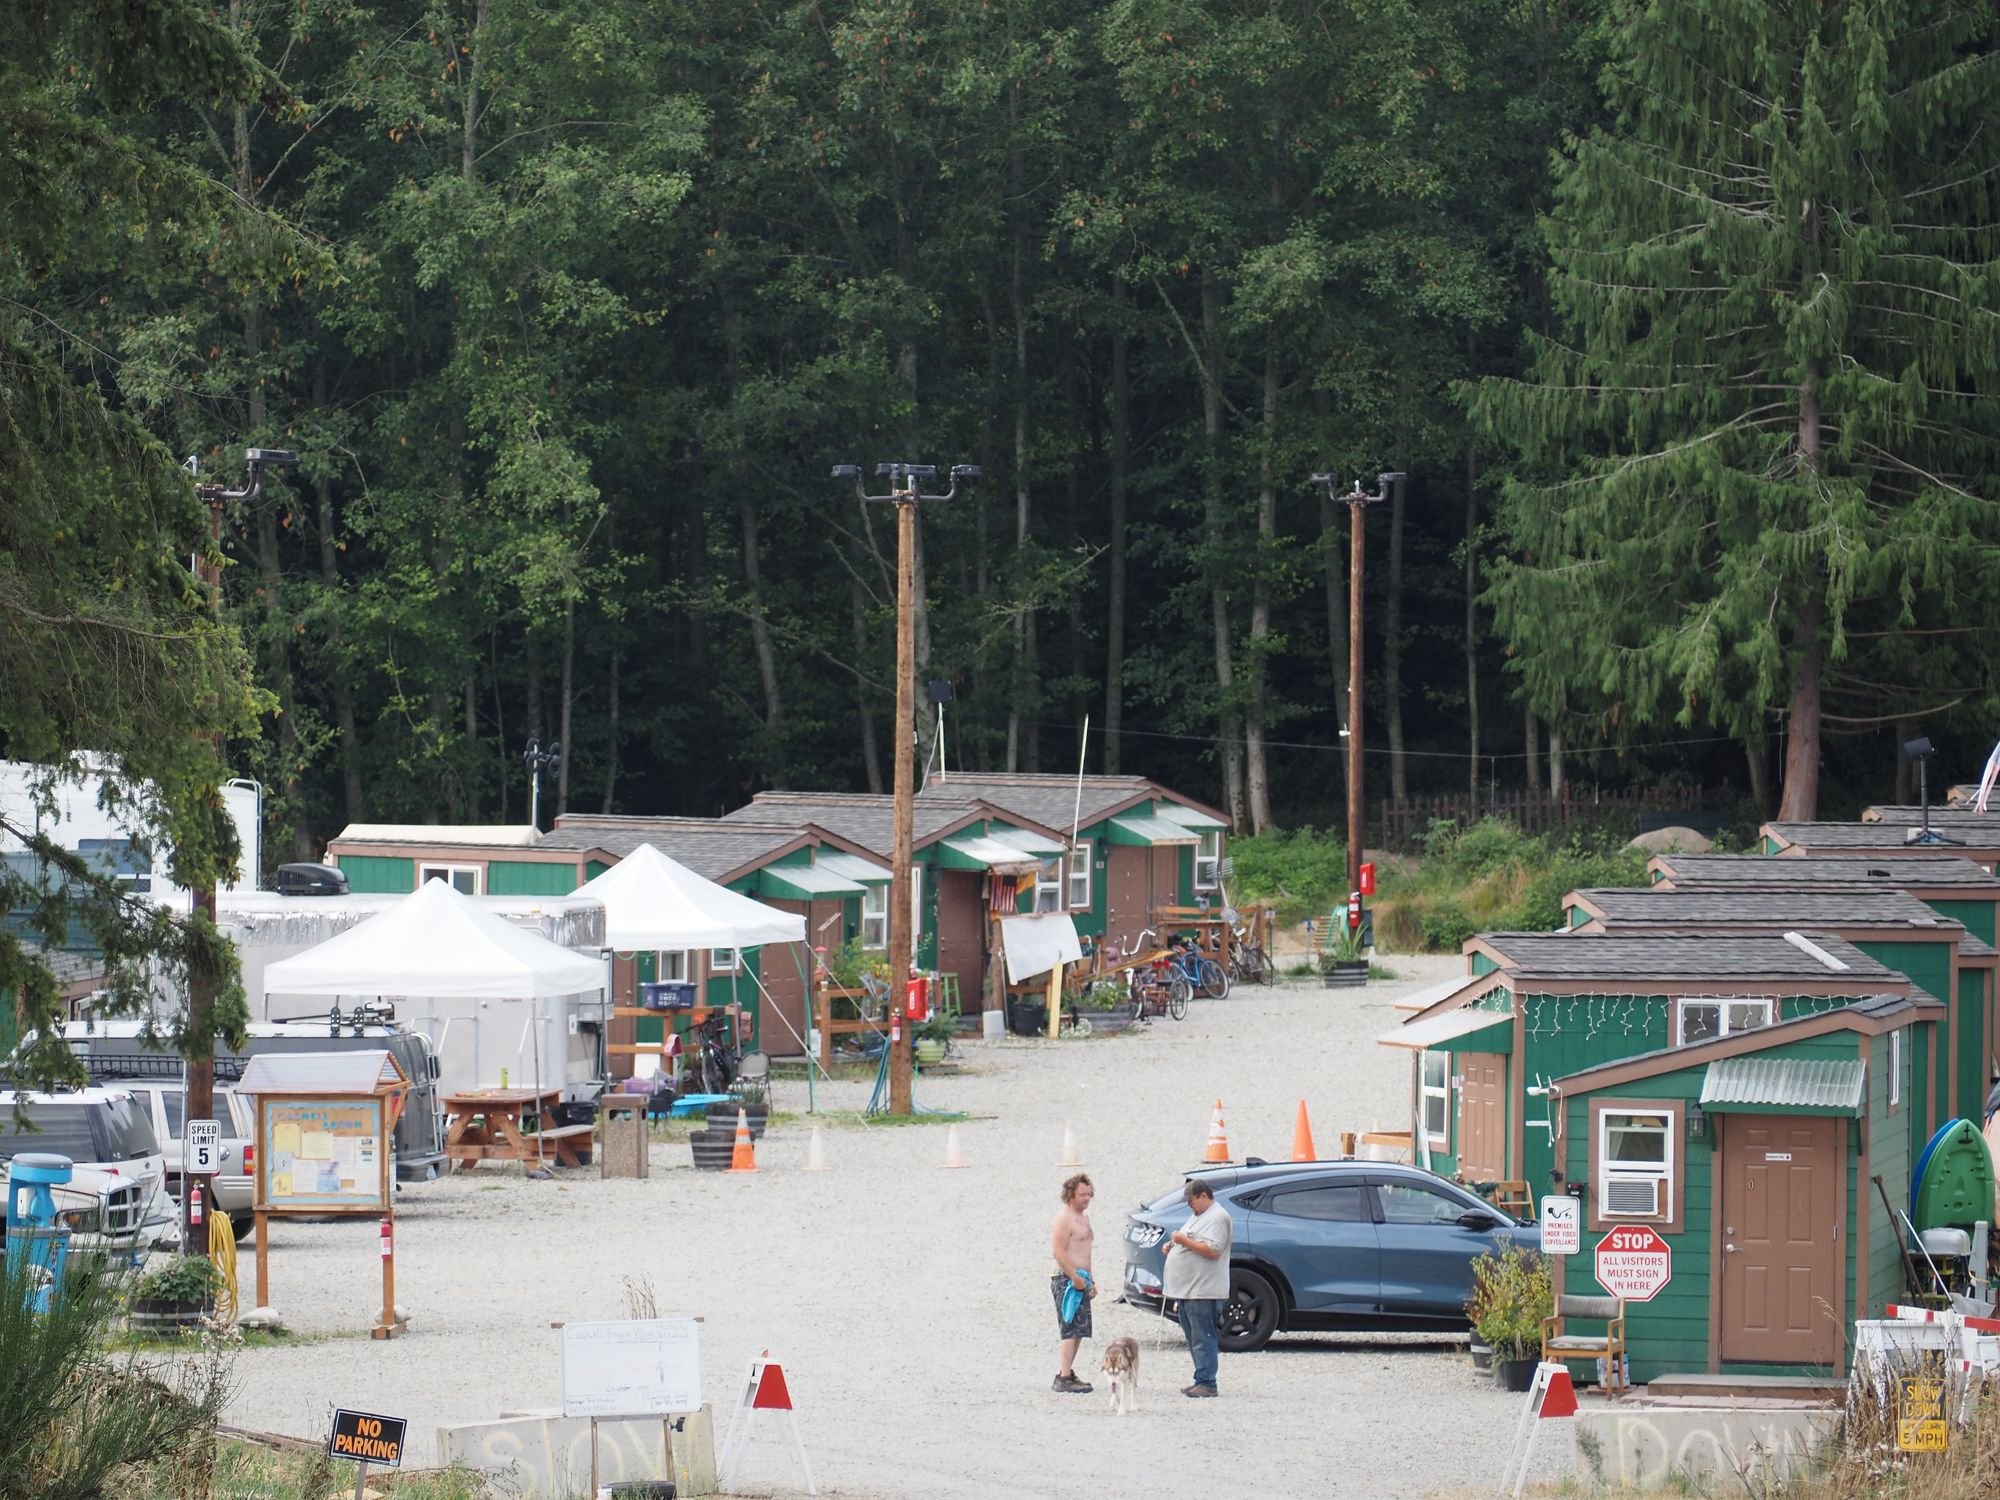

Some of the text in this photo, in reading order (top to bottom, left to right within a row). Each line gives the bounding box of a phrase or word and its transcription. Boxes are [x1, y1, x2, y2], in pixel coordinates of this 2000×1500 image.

[191, 1125, 217, 1135] SPEED
[192, 1136, 215, 1145] LIMIT
[198, 1147, 209, 1165] 5
[1547, 1222, 1573, 1230] PREMISES
[1612, 1233, 1654, 1249] STOP
[1603, 1257, 1663, 1266] ALL VISITORS
[1607, 1269, 1659, 1278] MUST SIGN
[1614, 1281, 1651, 1290] IN HERE
[1906, 1384, 1941, 1400] SLOW
[1905, 1402, 1941, 1417] DOWN
[357, 1418, 382, 1438] NO
[1903, 1432, 1943, 1445] 5 MPH
[334, 1434, 398, 1459] PARKING
